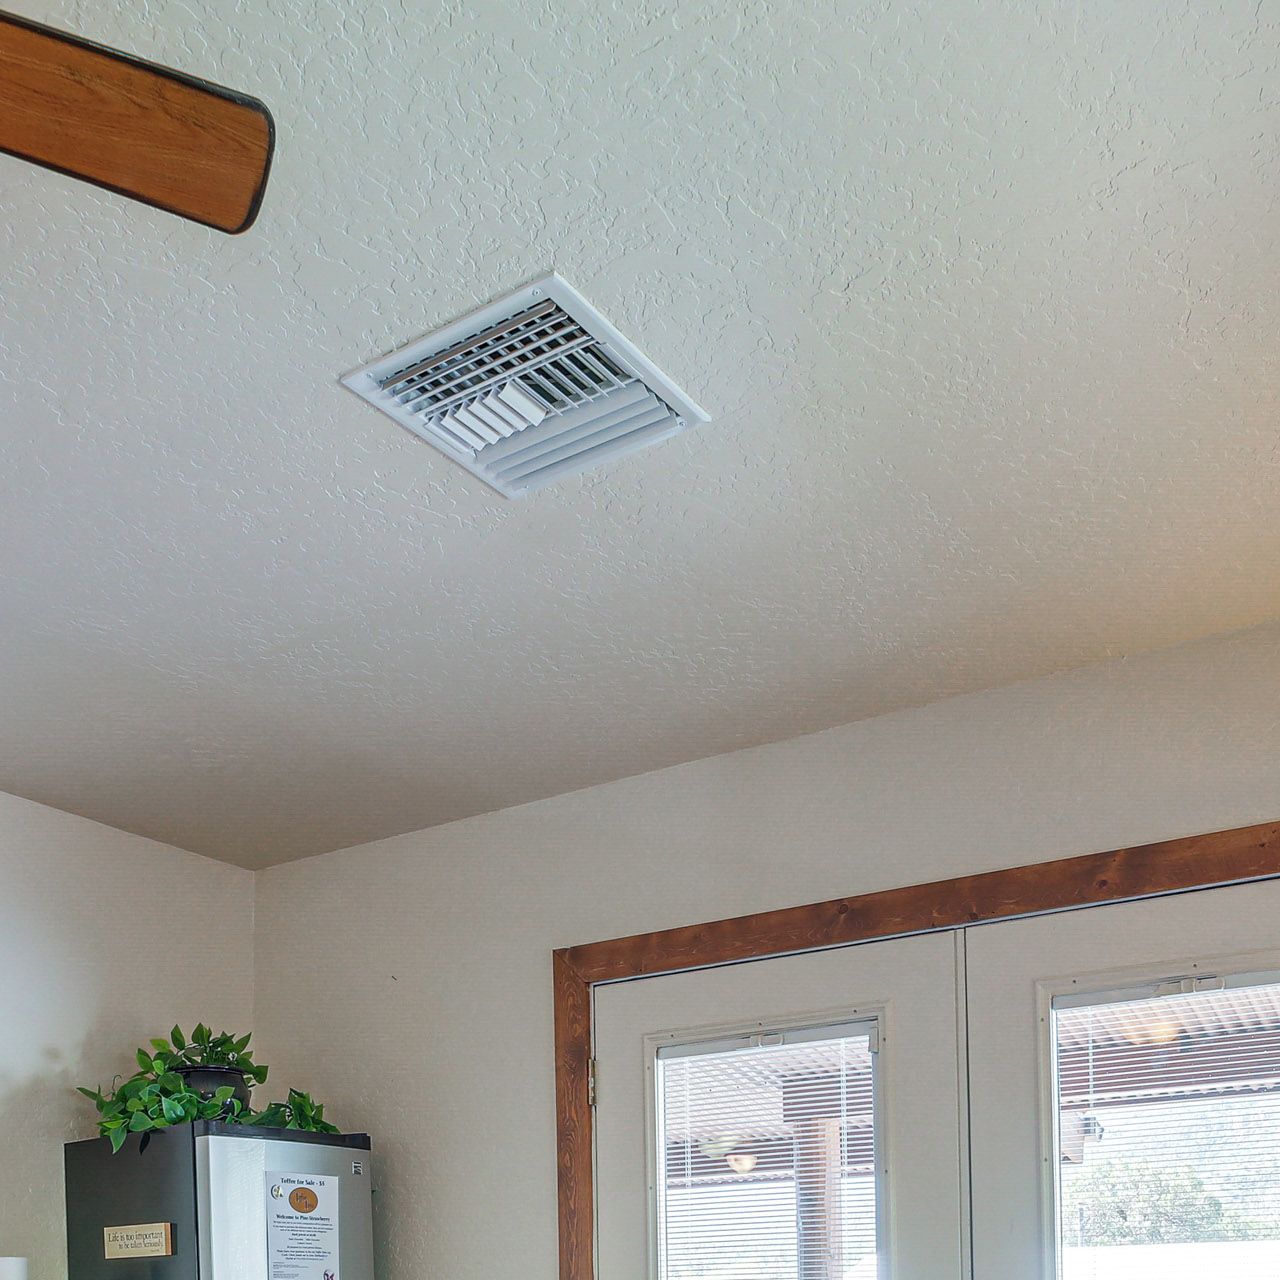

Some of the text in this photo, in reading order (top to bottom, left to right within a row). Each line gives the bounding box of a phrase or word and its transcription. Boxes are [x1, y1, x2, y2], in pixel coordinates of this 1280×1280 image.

[108, 1232, 119, 1242] Life
[120, 1232, 125, 1242] is
[135, 1231, 163, 1240] important
